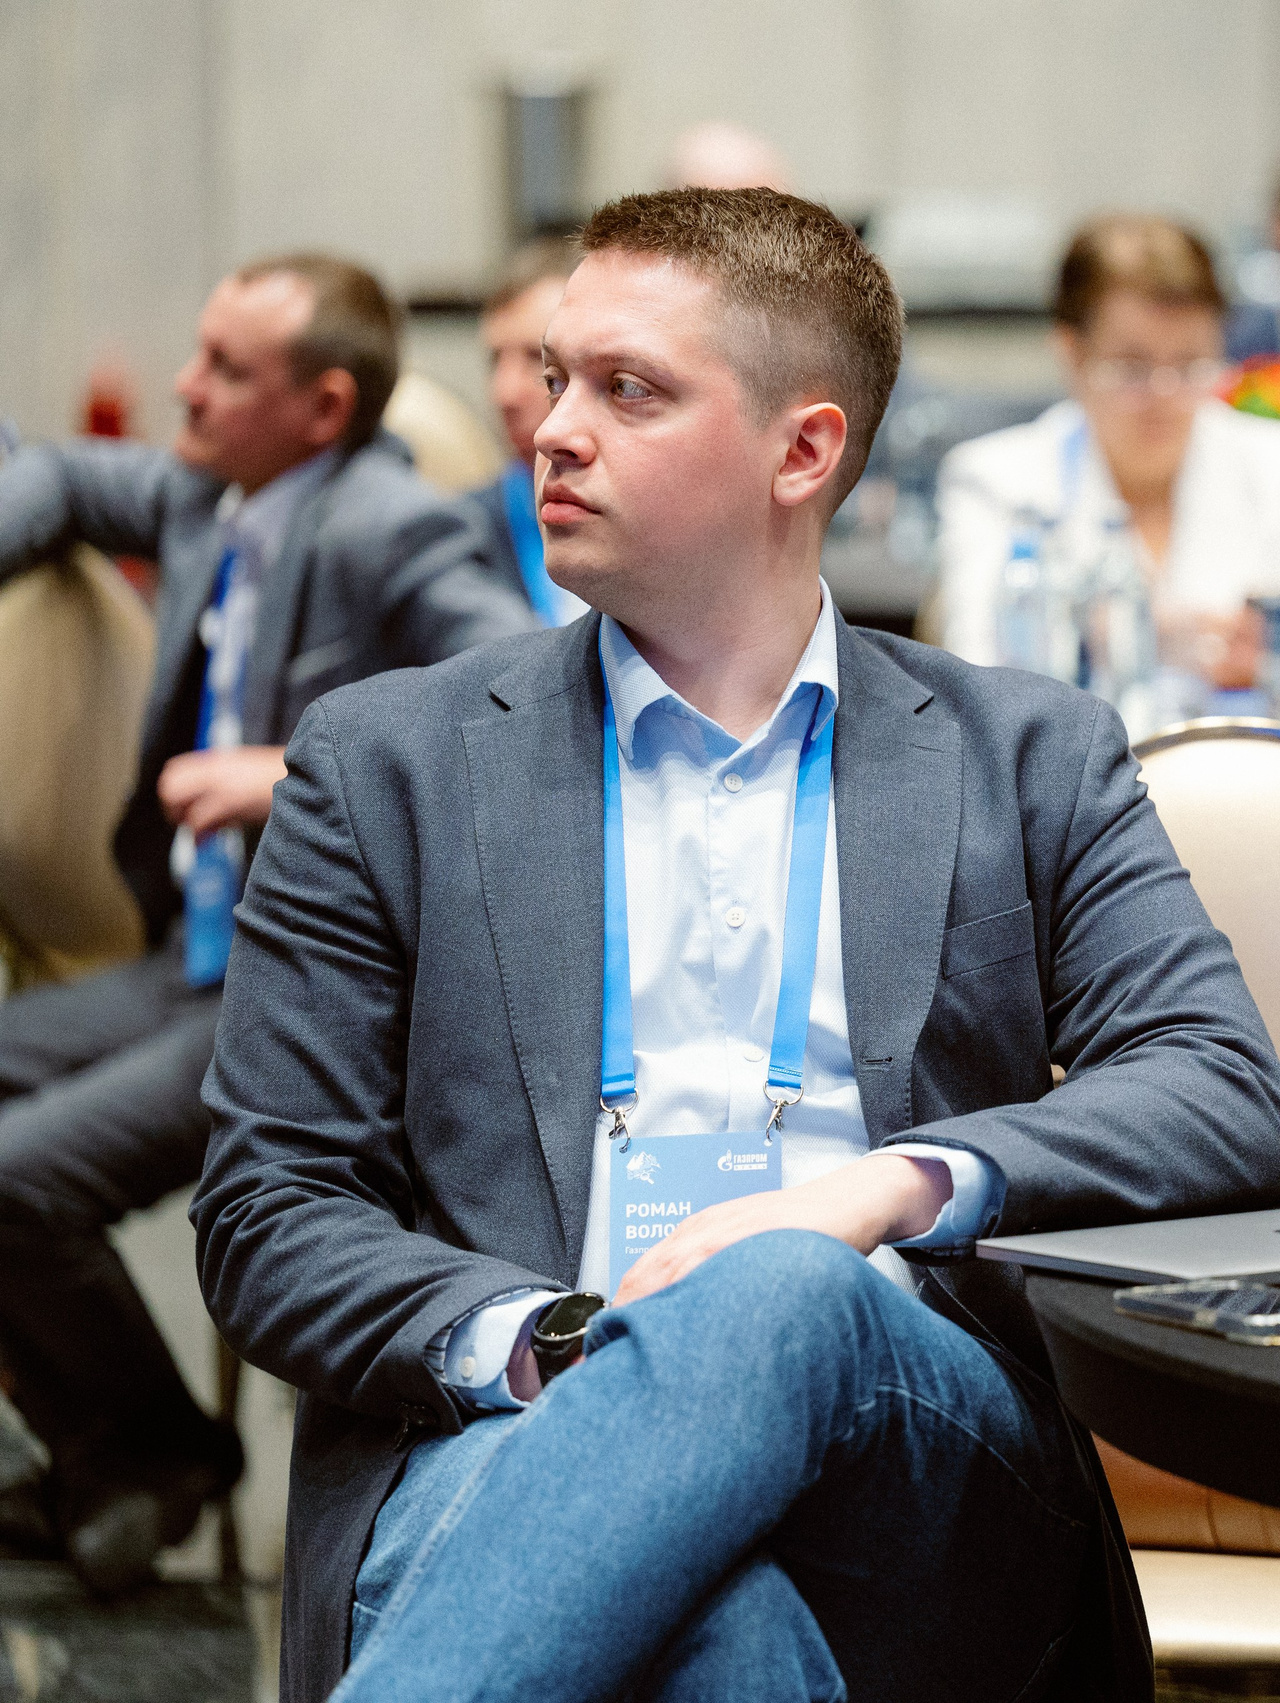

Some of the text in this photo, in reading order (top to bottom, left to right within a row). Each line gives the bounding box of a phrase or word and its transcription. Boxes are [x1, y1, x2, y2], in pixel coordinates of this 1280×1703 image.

[733, 1153, 768, 1164] ГАЗПРОМ
[625, 1201, 691, 1218] РОМАН
[625, 1223, 680, 1239] ВОЛО
